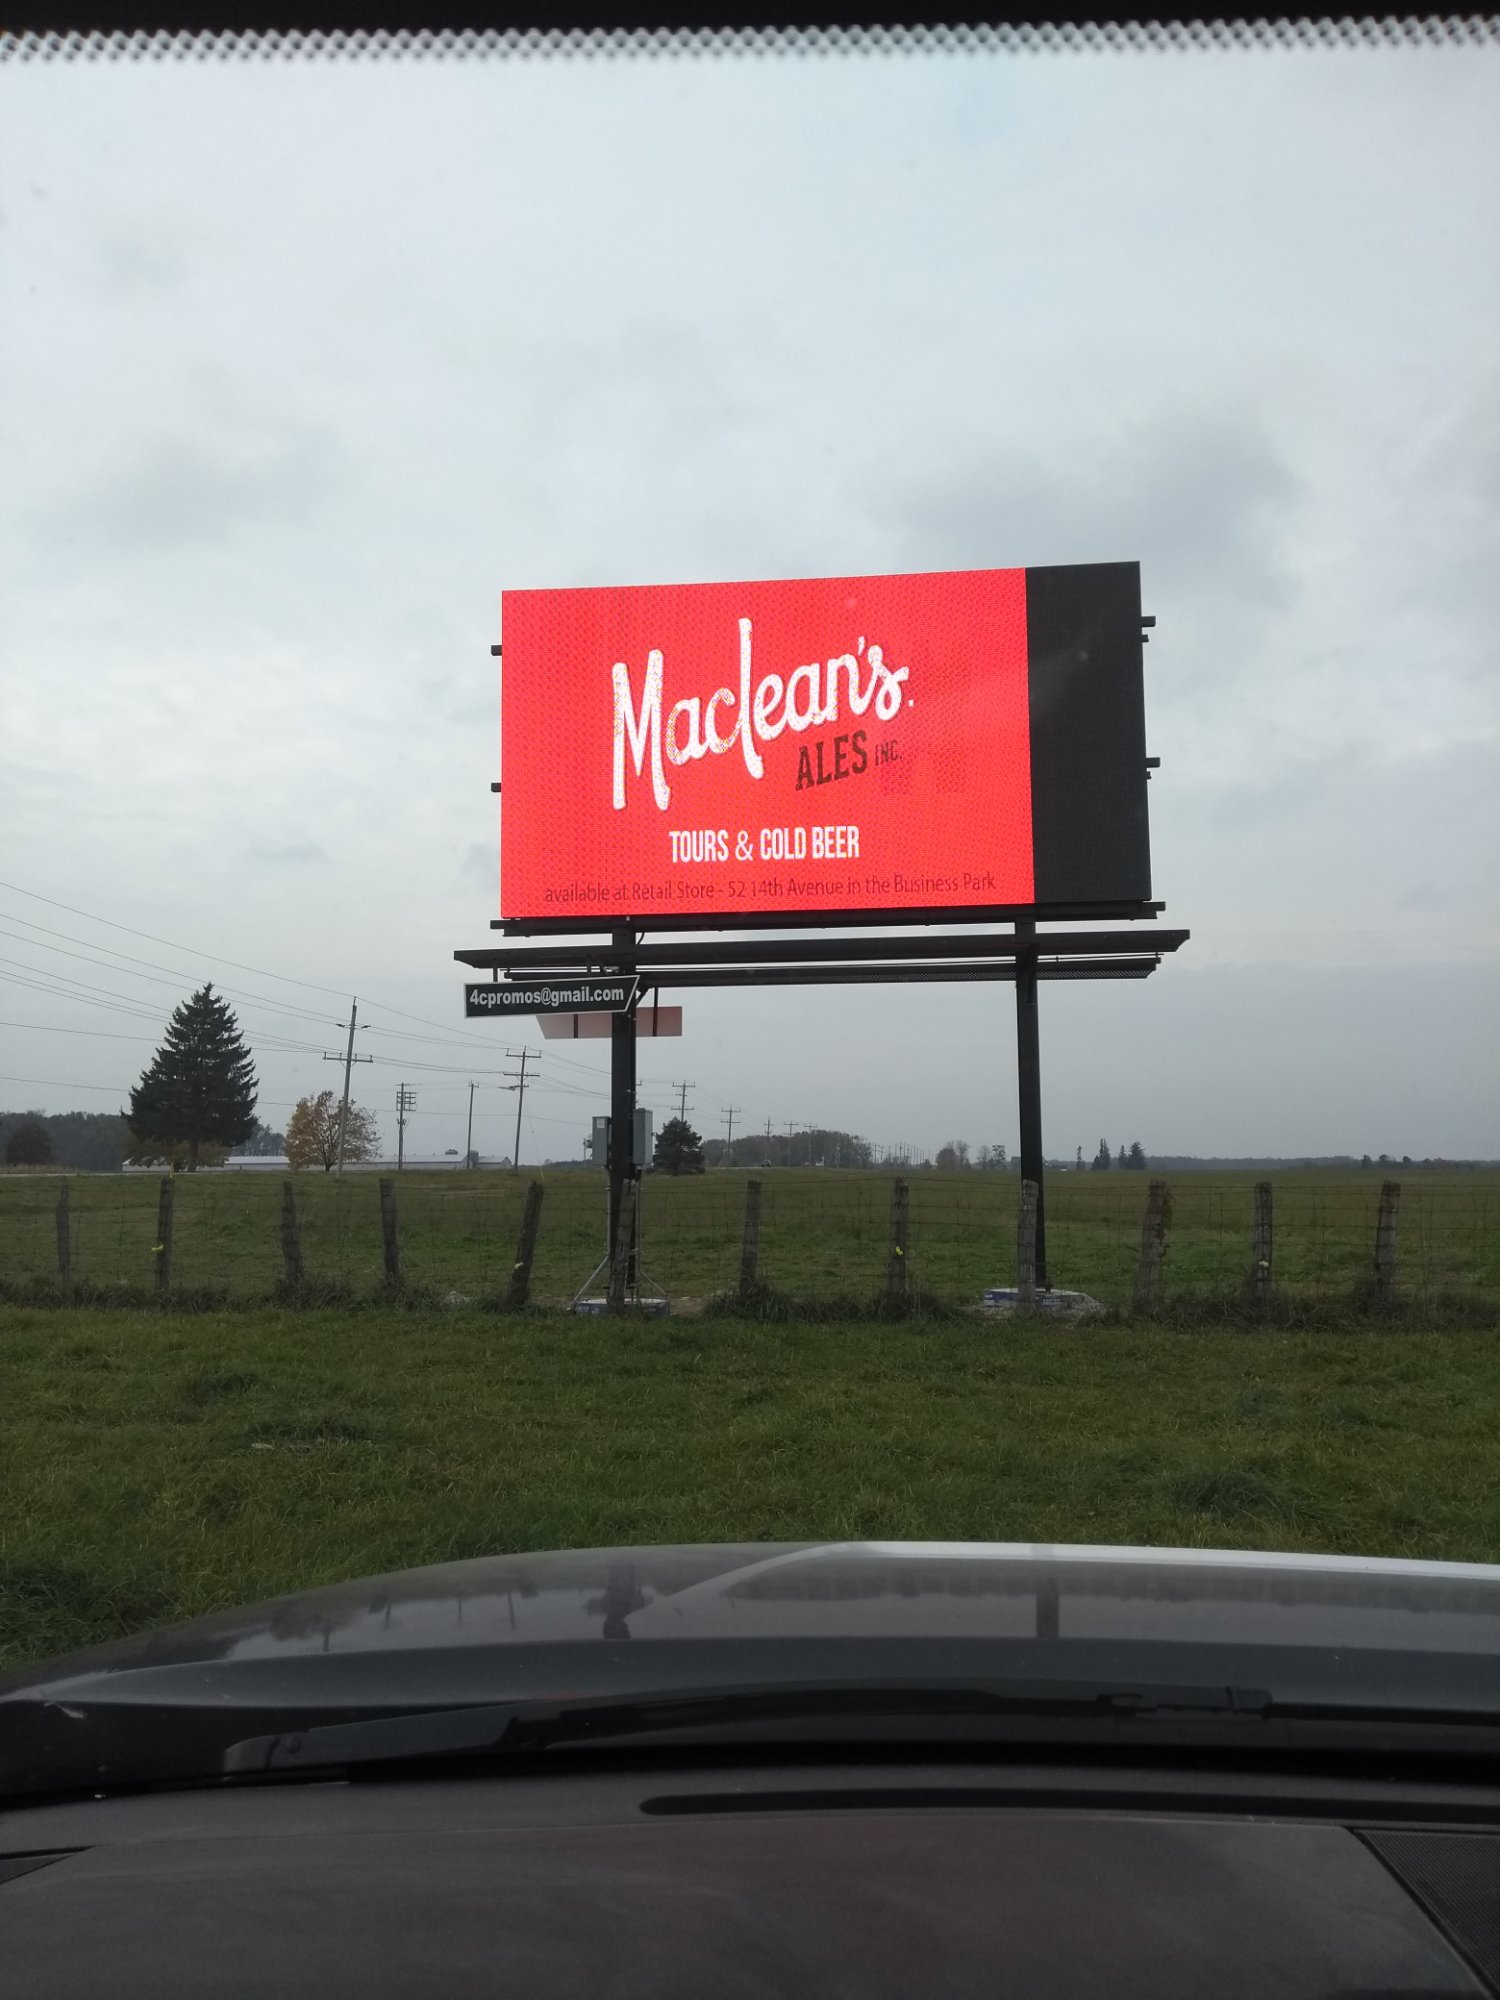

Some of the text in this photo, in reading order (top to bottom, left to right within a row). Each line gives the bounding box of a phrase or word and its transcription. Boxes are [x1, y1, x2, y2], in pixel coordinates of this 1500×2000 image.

[795, 729, 868, 791] ALES
[669, 825, 860, 863] TOURS & COLD BEER
[545, 883, 610, 902] available
[613, 883, 628, 900] at
[632, 880, 672, 900] Retail
[728, 880, 746, 898] 52
[752, 878, 783, 898] 14th
[787, 877, 843, 896] Avenue
[847, 876, 861, 895] in
[865, 874, 891, 894] the
[894, 874, 959, 894] Business
[963, 872, 997, 891] Park
[469, 986, 624, 1008] 4cpromos@gmail.com
